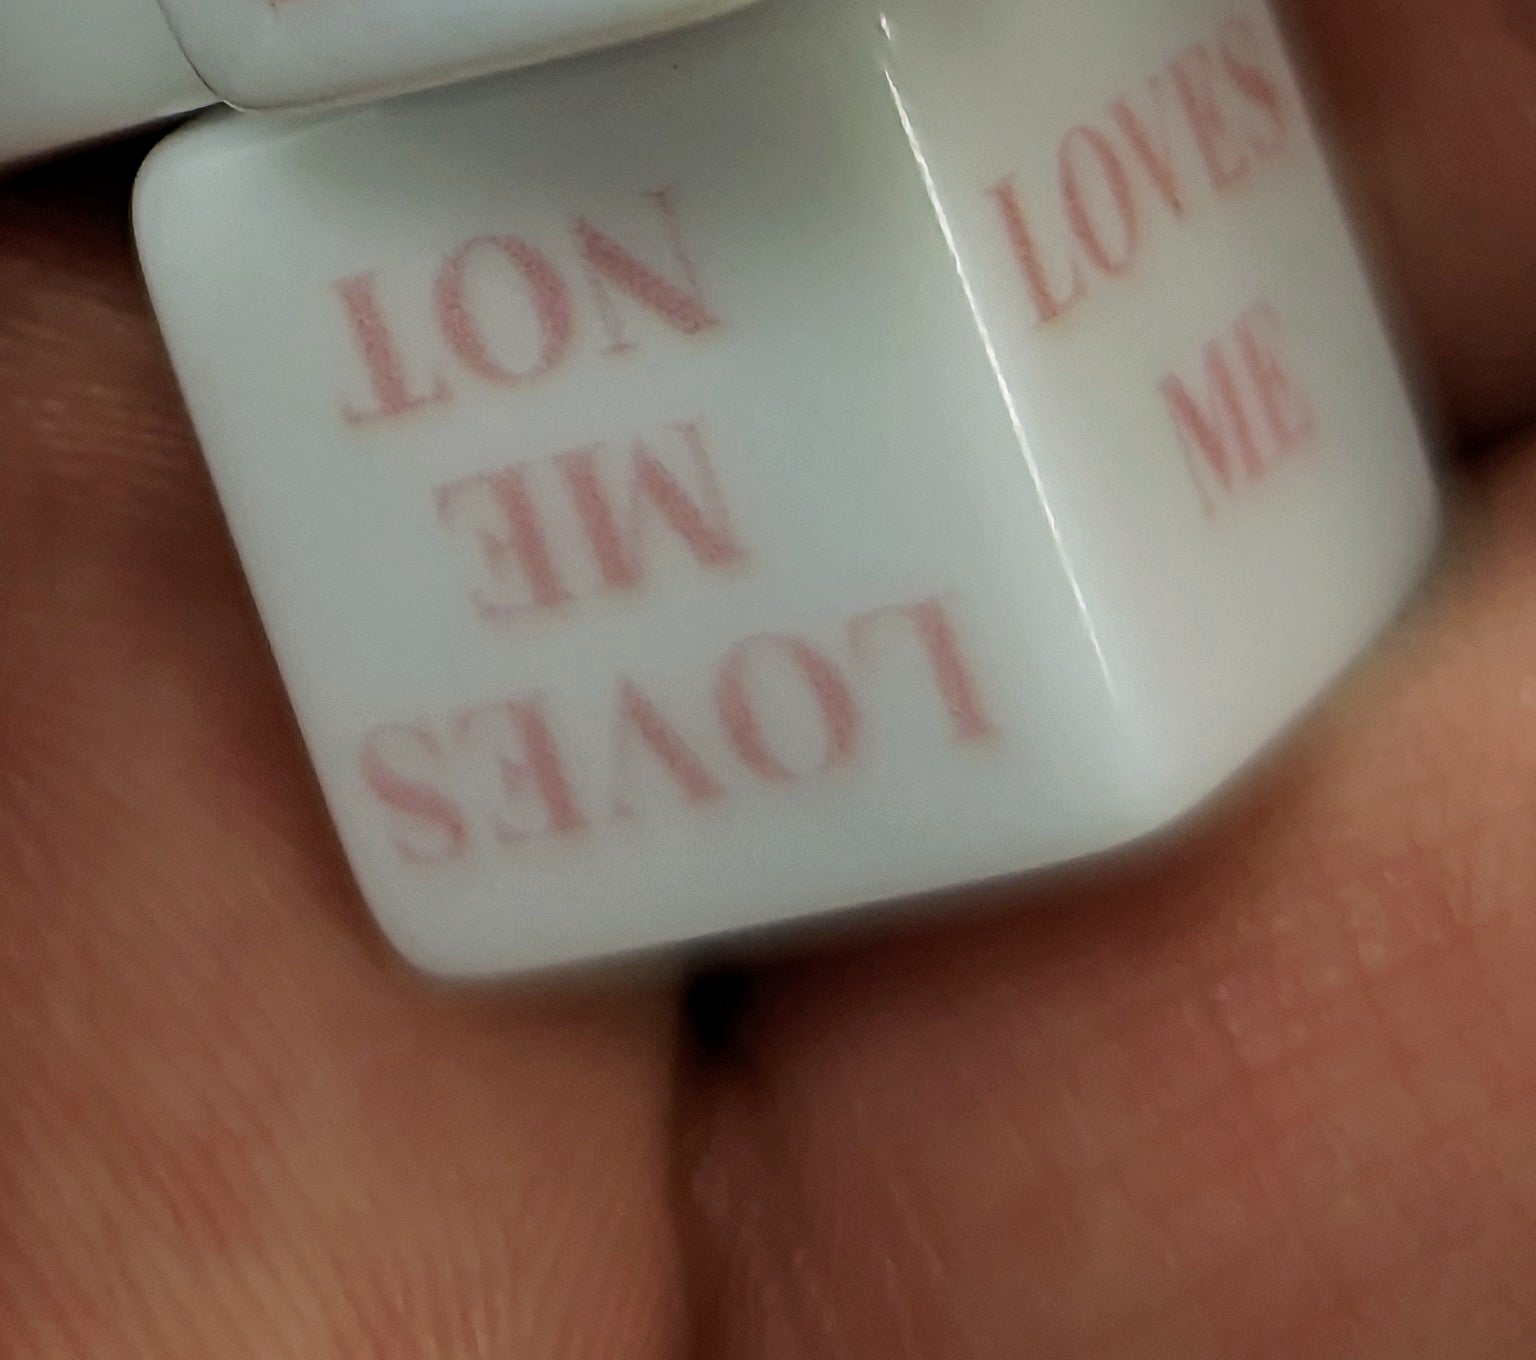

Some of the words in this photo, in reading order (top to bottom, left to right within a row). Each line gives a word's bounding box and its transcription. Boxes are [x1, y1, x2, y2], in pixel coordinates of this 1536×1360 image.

[984, 12, 1293, 330] LOVES
[330, 182, 726, 428] NOT
[1156, 294, 1320, 523] ME
[430, 416, 752, 627] ME
[354, 590, 1005, 874] LOVES
